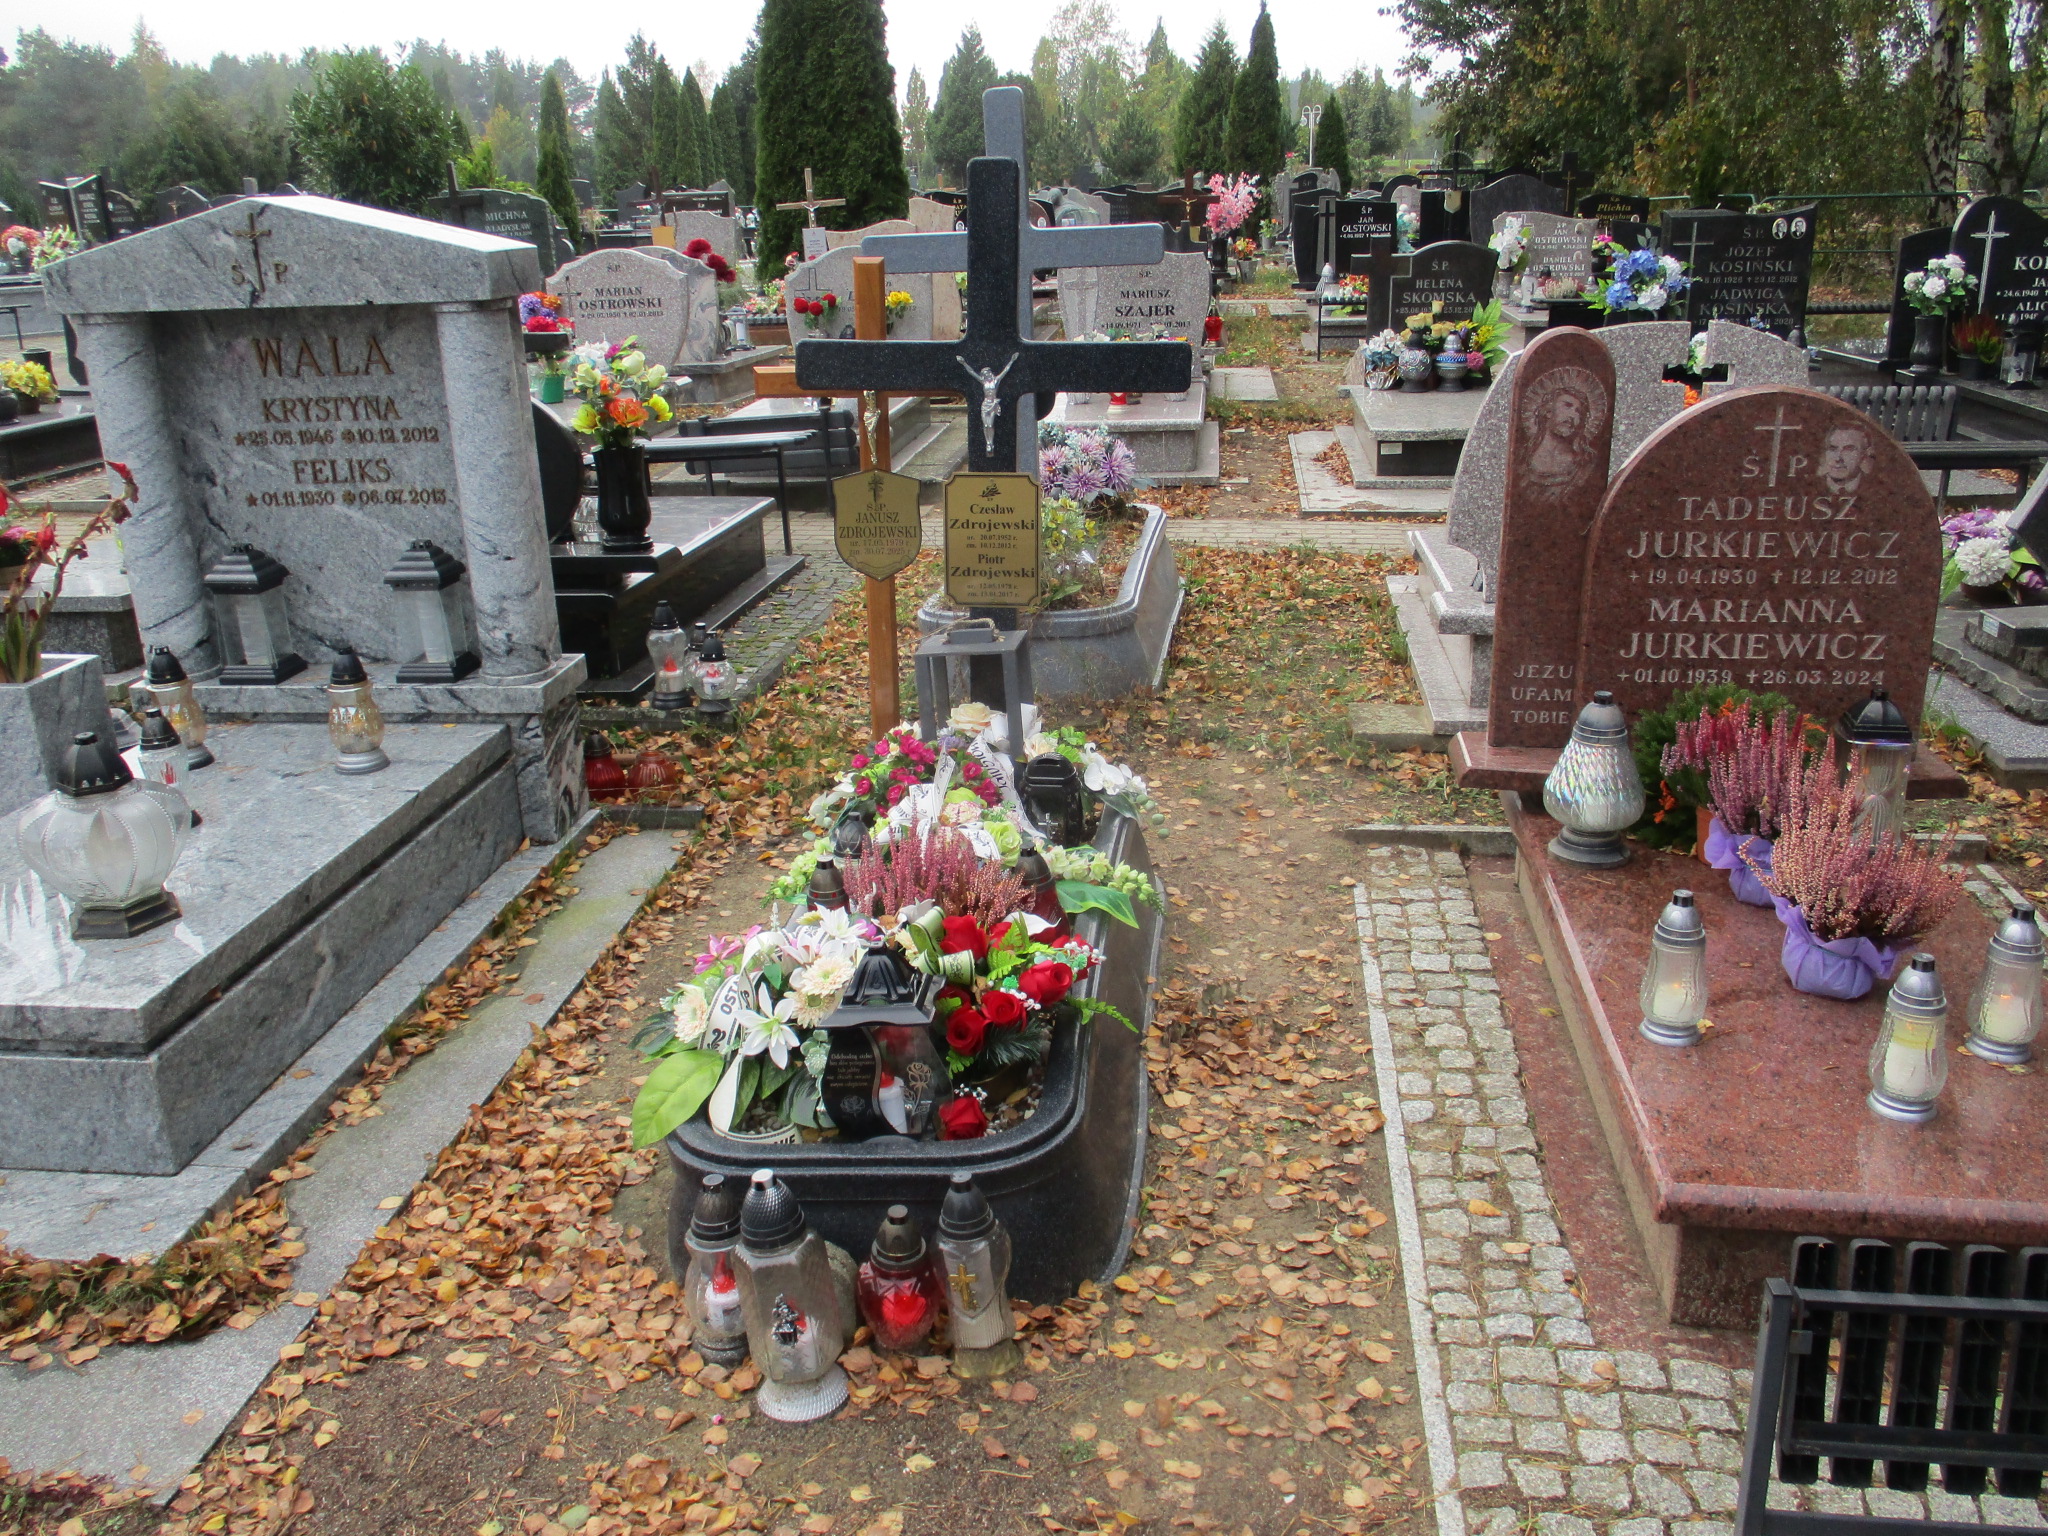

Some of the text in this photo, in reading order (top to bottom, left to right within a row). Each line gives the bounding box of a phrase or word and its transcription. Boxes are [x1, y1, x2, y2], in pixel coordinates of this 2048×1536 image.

[1597, 203, 1632, 212] Plichta
[485, 211, 529, 222] MICHNA
[1341, 223, 1392, 233] OLSTOWSKI
[1535, 236, 1587, 244] OSTROWSKI
[1725, 244, 1776, 257] JÓZEF
[1543, 256, 1572, 264] DANIEL
[1709, 258, 1793, 273] KOSIŃSKI
[1416, 279, 1463, 289] HELENA
[595, 286, 643, 297] MARIAN
[1120, 289, 1171, 299] MARIUSZ
[1402, 291, 1476, 304] SKOMSKA
[1710, 287, 1784, 300] JADWIGA
[579, 298, 662, 311] OSTROWSKI
[1115, 304, 1175, 318] SZAJER
[1700, 301, 1790, 316] KOSIŃSKA
[252, 336, 395, 377] WALA
[261, 395, 402, 423] KRYSTYNA
[292, 458, 392, 484] FELIKS
[1679, 496, 1857, 521] TADEUSZ
[855, 512, 899, 524] JANUSZ
[950, 519, 1035, 532] Zdrojewski
[839, 526, 917, 539] ZDROJEWSKI
[1627, 531, 1900, 559] JURKIEWICZ
[978, 553, 1005, 564] Piotr
[951, 566, 1035, 579] Zdrojewski
[1648, 568, 1898, 585] 19.04.1930 12.12.2012
[1648, 599, 1864, 623] MARIANNA
[1620, 632, 1887, 660] JURKIEWICZ
[1513, 664, 1574, 679] JEZU
[1634, 668, 1884, 686] 01.10.1939 26.03.2024
[1510, 686, 1573, 702] UFAM
[1510, 710, 1570, 724] TOBIE
